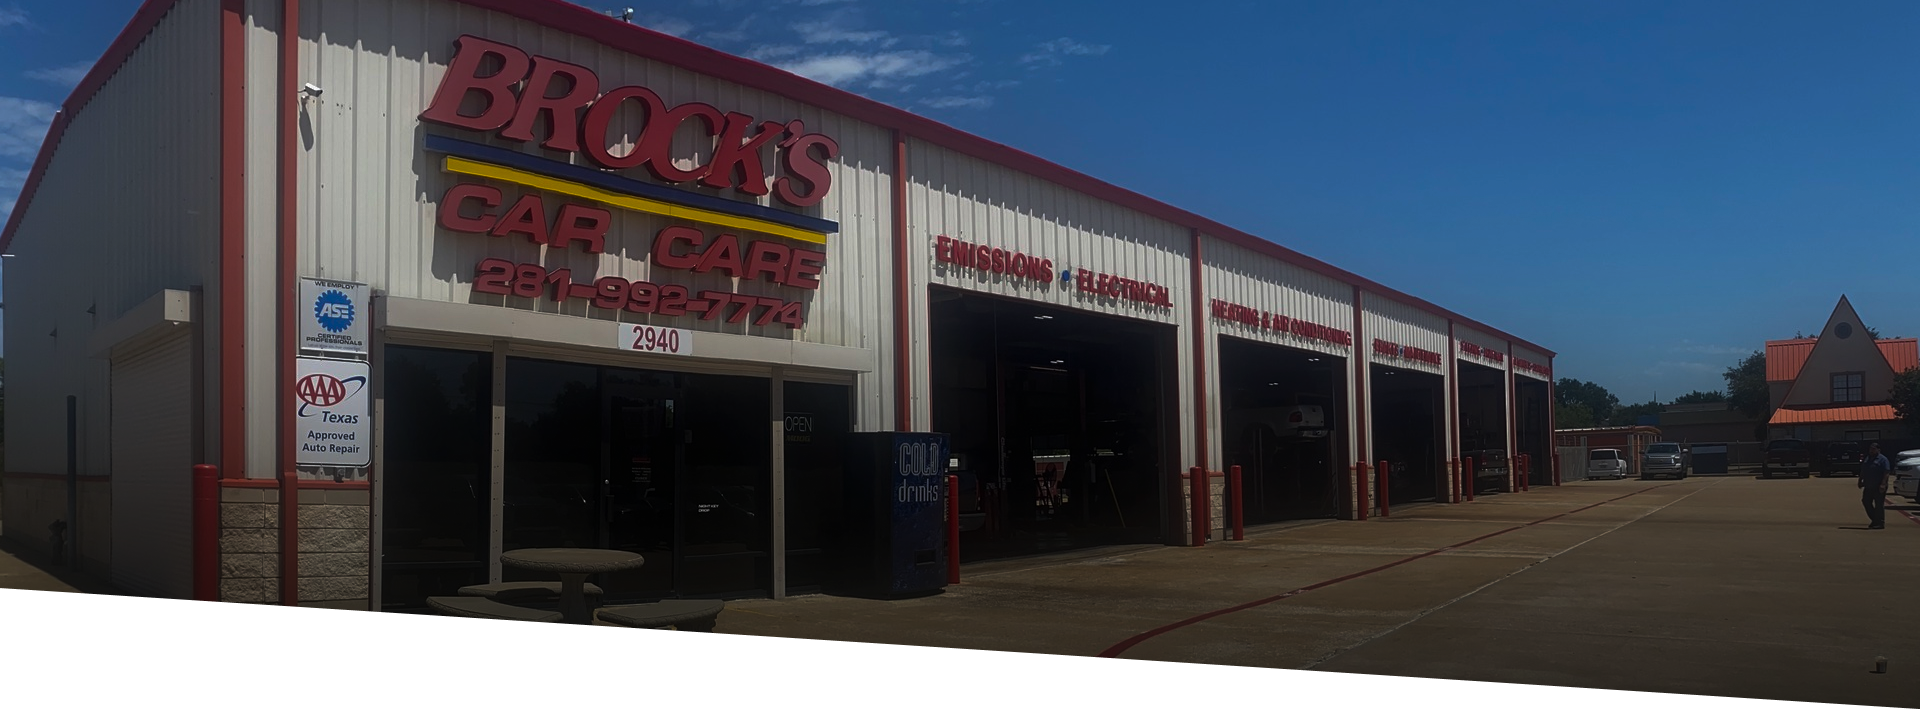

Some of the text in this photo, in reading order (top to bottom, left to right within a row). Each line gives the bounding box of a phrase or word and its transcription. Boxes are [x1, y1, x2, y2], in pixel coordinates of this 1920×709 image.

[419, 34, 839, 207] BROCK'S
[438, 182, 826, 290] CAR CARE
[937, 235, 1173, 307] EMISSIONS ELECTRICAL
[327, 282, 355, 290] EMPLOY
[473, 257, 804, 329] 281-992-7774
[319, 303, 349, 319] ASE
[1212, 299, 1351, 346] HEATING & AIR CONDITIONING
[306, 337, 362, 346] PROFESSIONALS
[318, 333, 351, 341] CERTIFIED
[632, 325, 679, 353] 2940
[302, 375, 342, 406] AAA
[322, 411, 358, 424] Texas
[785, 416, 811, 432] OPEN
[307, 430, 355, 443] Approved
[302, 443, 360, 454] Auto Repair
[900, 443, 939, 476] COLD
[899, 479, 938, 502] drinks
